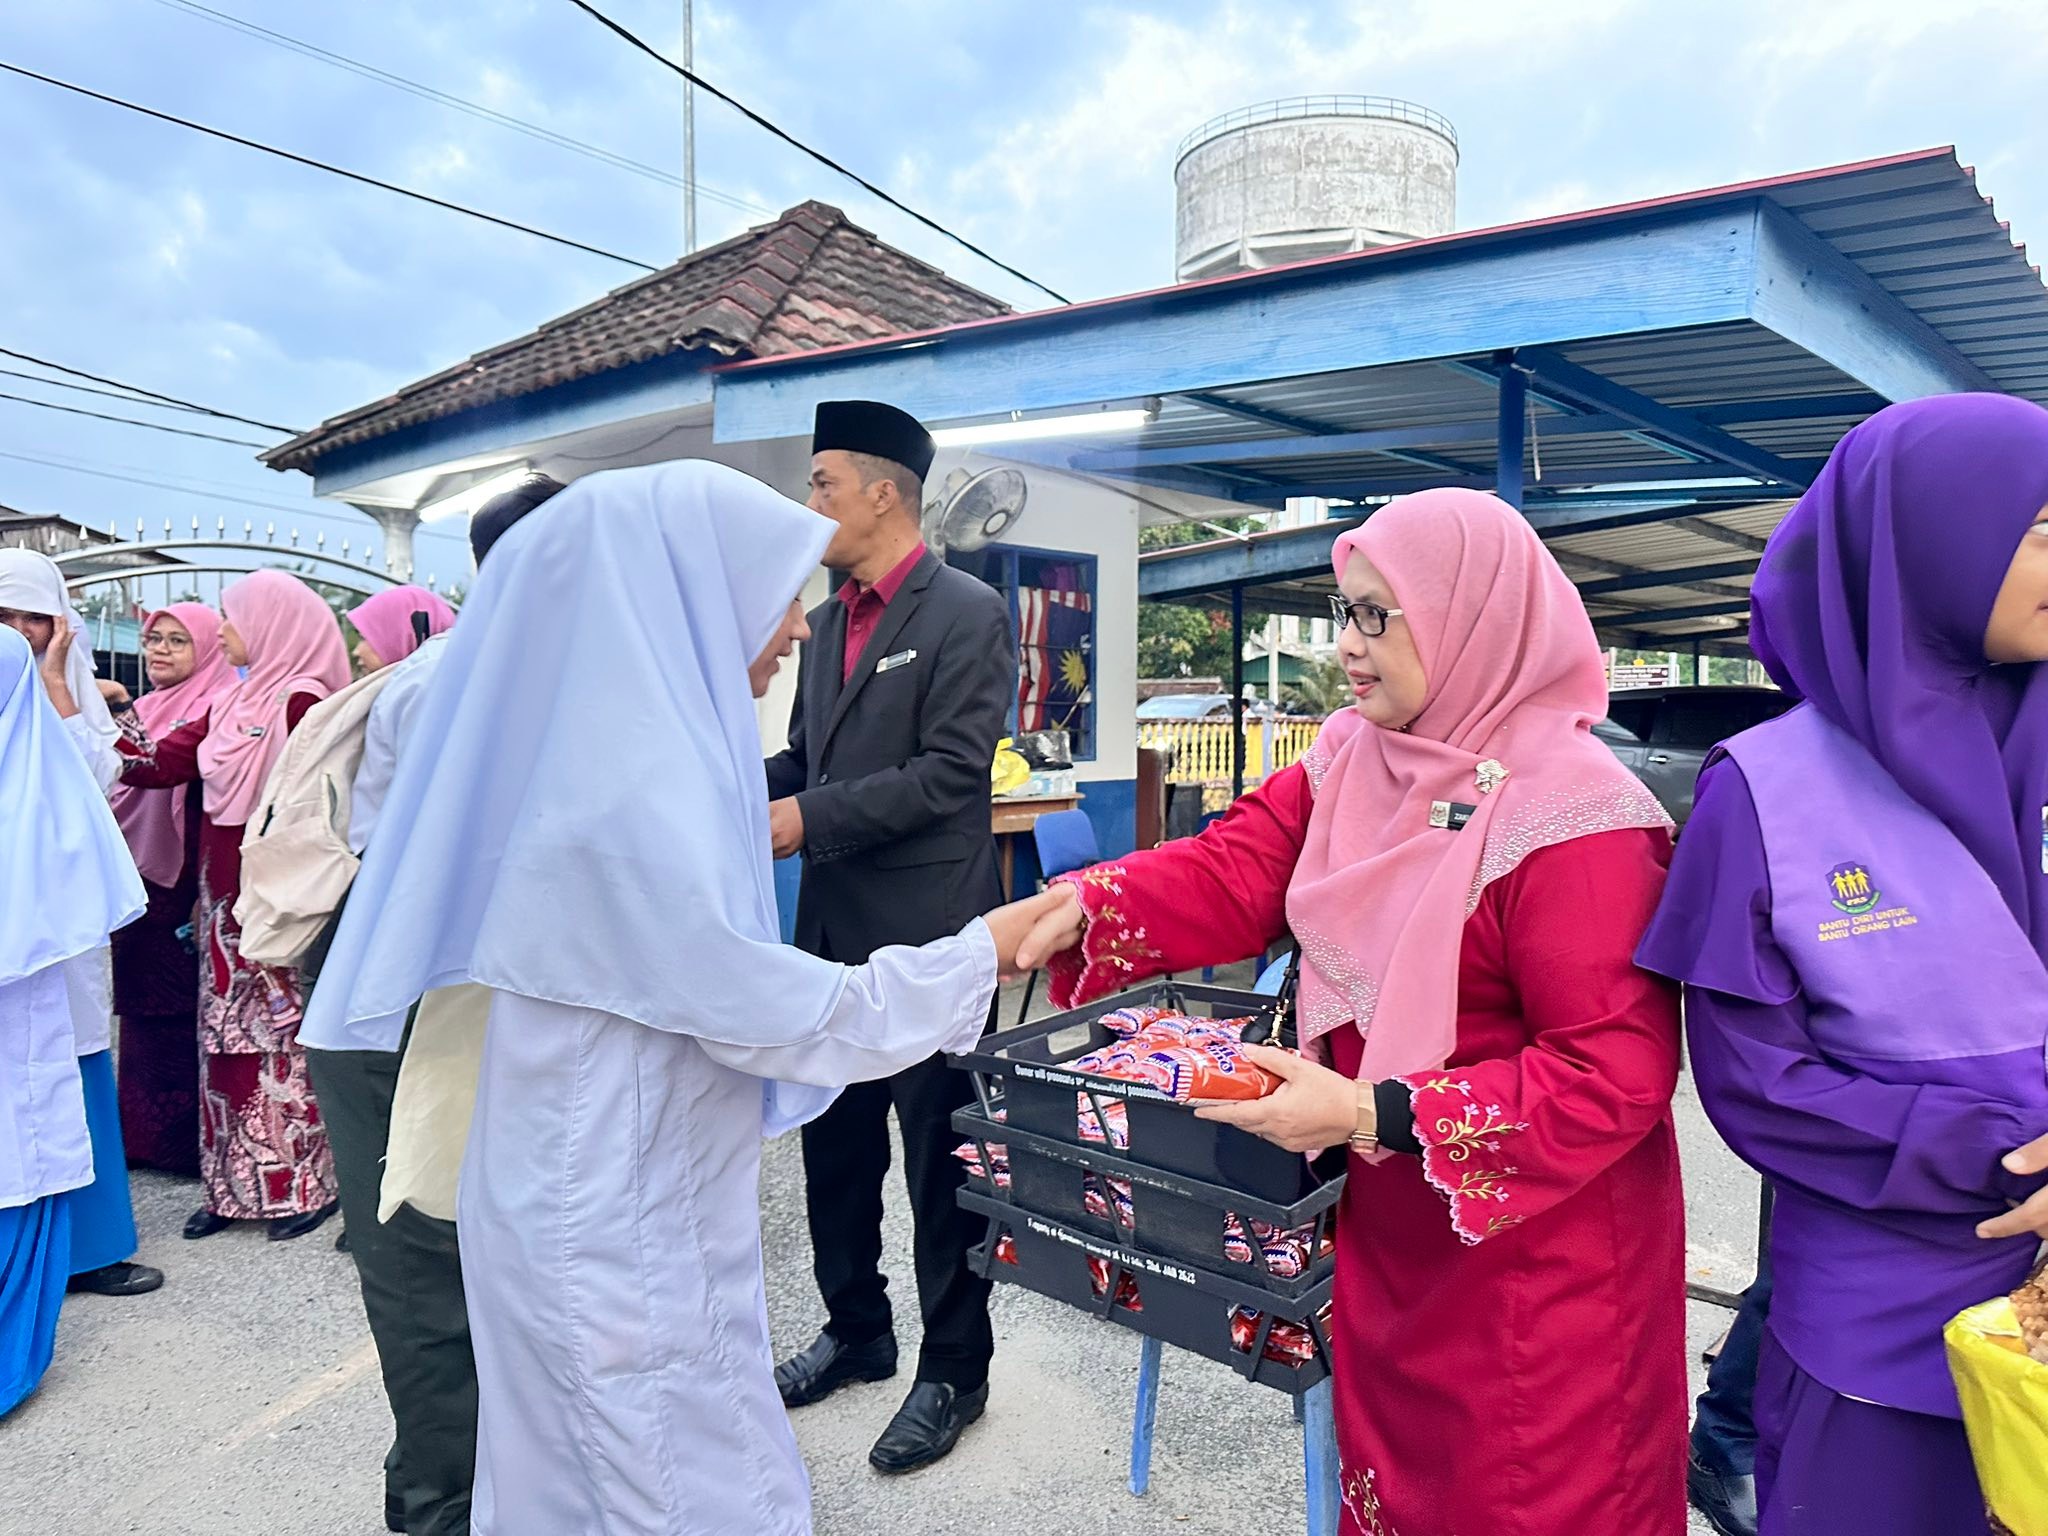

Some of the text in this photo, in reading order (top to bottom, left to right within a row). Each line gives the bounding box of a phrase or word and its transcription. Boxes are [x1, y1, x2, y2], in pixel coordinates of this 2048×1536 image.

[1818, 916, 1918, 942] BANTU ORANG LAIN
[1819, 907, 1909, 931] BANTU DIRI UNTUK
